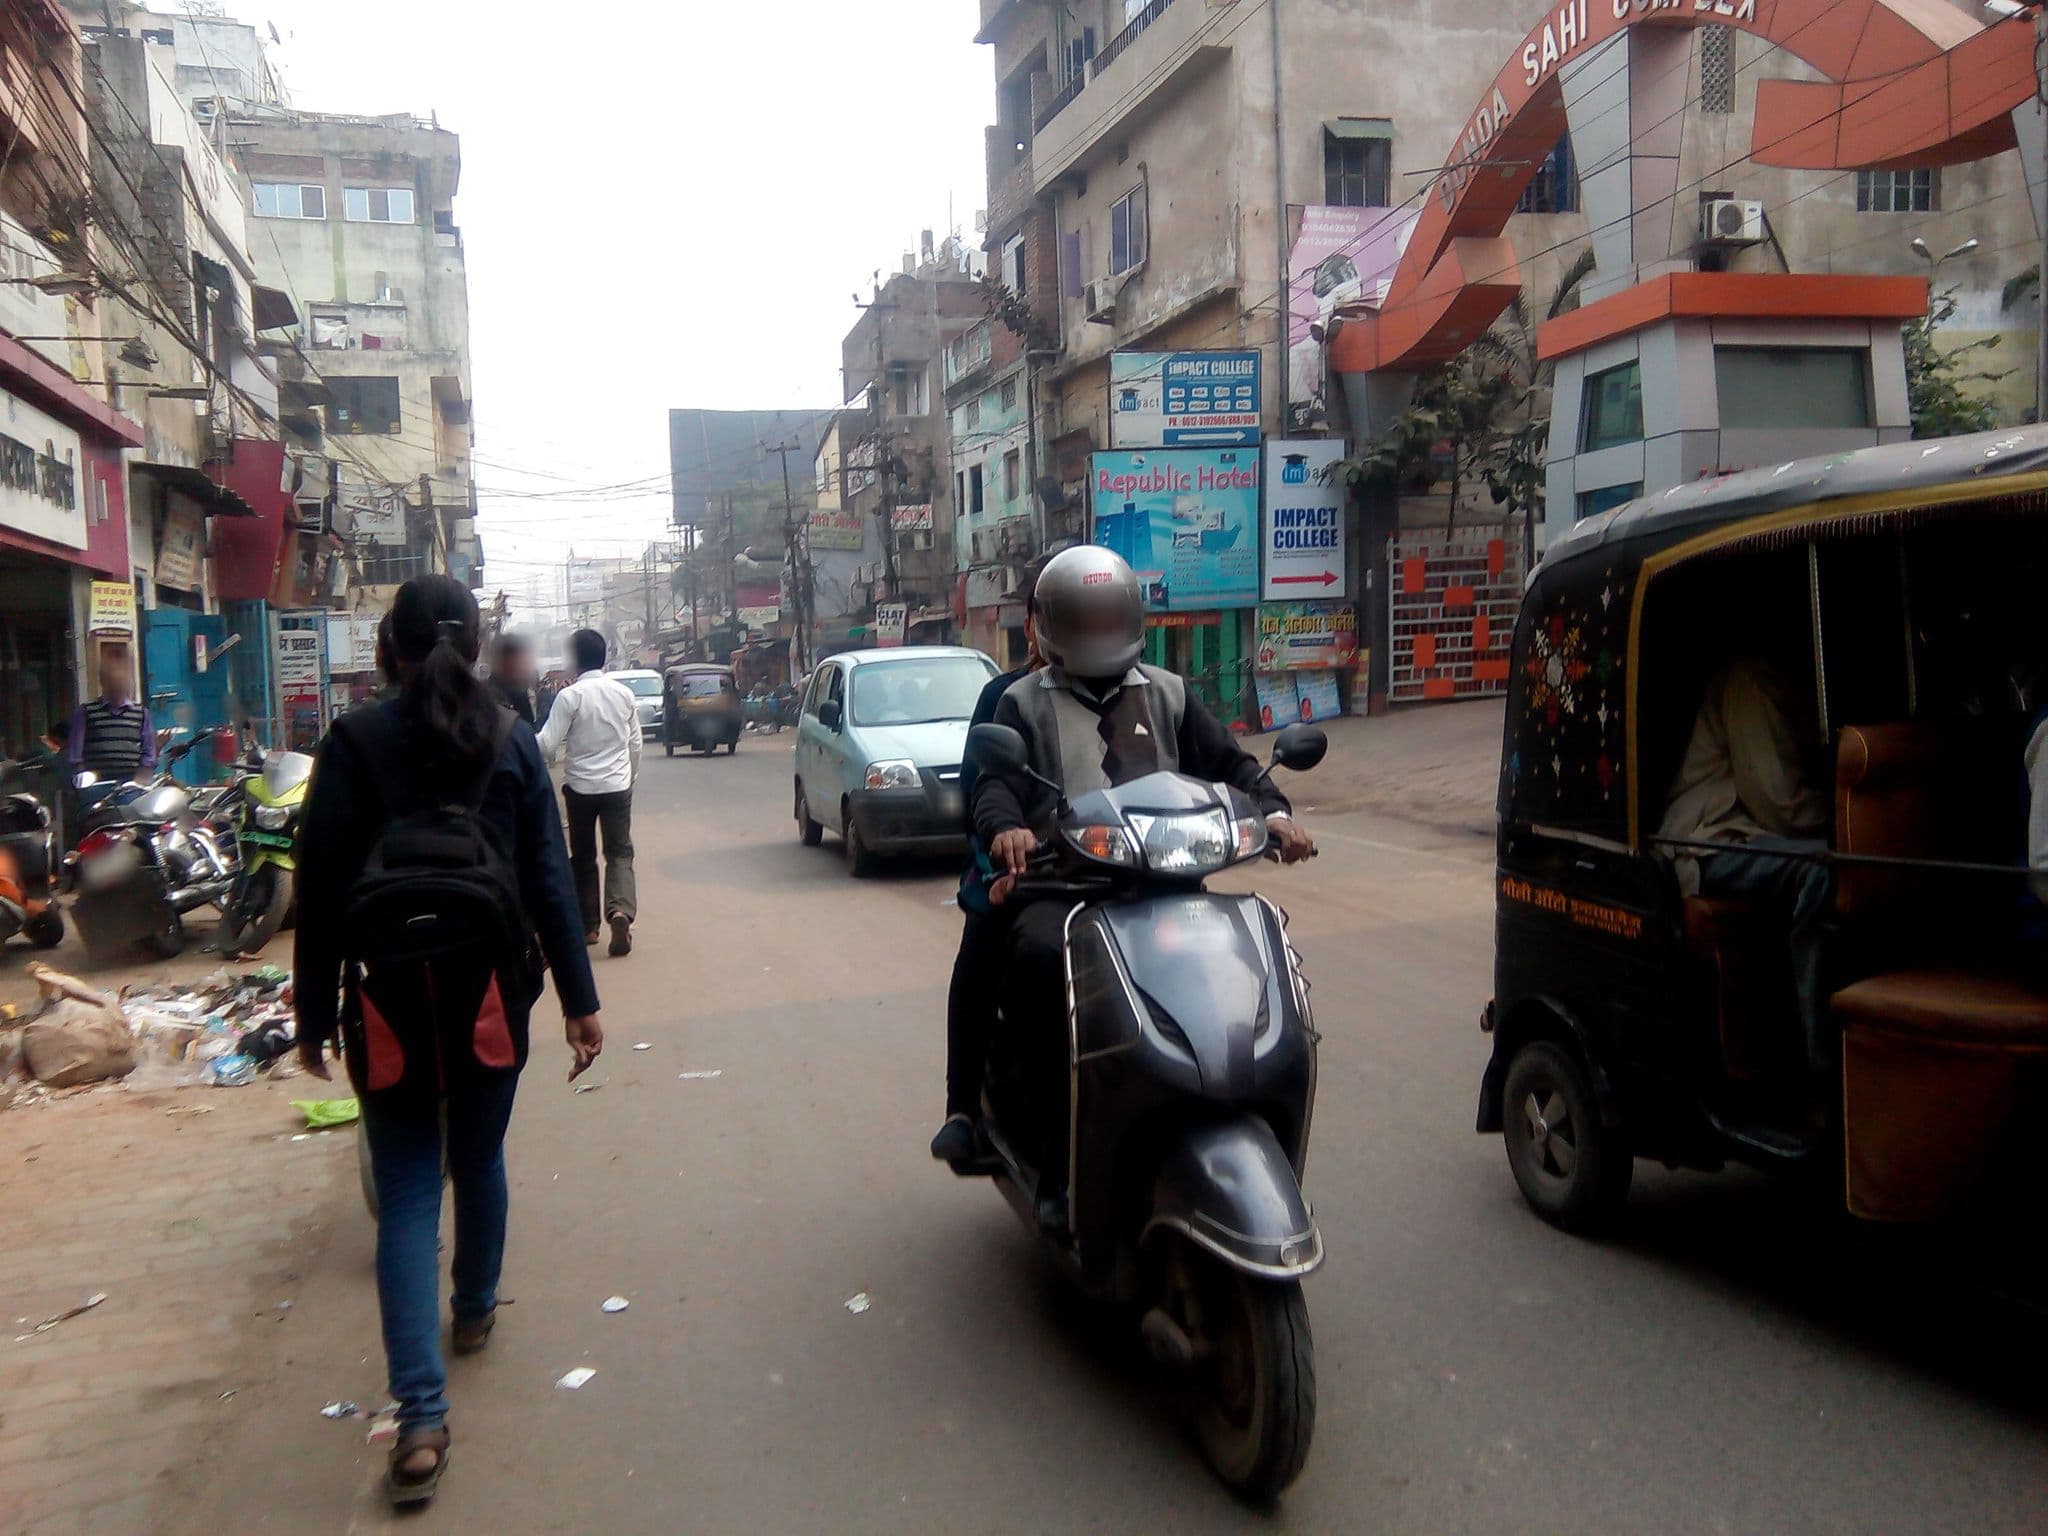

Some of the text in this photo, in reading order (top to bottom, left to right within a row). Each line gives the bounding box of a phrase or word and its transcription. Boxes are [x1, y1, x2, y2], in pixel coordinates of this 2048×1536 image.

[1523, 0, 1588, 87] SAHI
[1211, 360, 1255, 375] COLLEGE
[1098, 461, 1258, 499] Republic Hotel
[1274, 507, 1338, 528] IMPACT
[1273, 528, 1338, 549] COLLEGE
